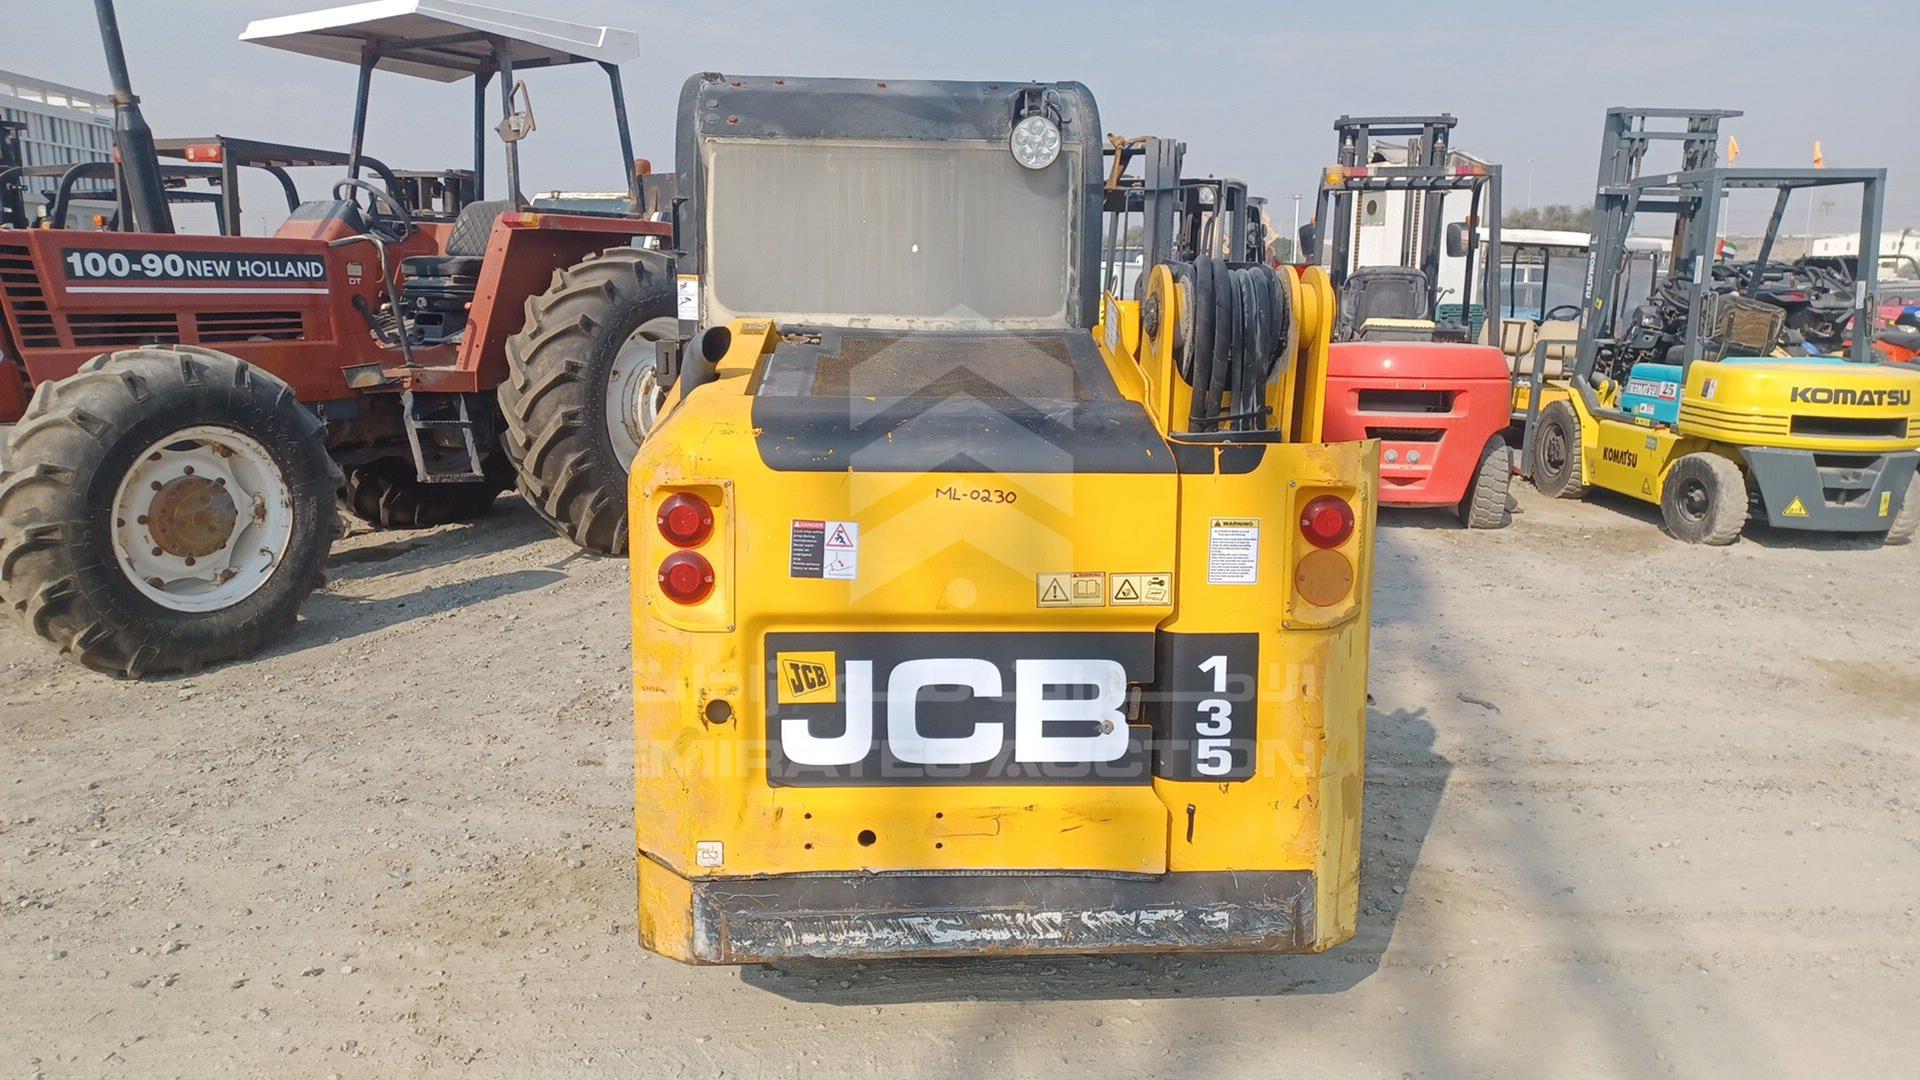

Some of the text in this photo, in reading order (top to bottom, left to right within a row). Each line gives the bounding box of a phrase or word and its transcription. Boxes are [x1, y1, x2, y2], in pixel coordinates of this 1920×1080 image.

[65, 251, 325, 279] 100-90 NEW HOLLAND
[1662, 382, 1675, 397] 25
[1790, 386, 1912, 407] KOMATSU
[1602, 446, 1639, 469] KOMATSU
[935, 486, 1018, 504] ML-0230
[788, 661, 828, 695] JCB
[780, 657, 1130, 766] JCB
